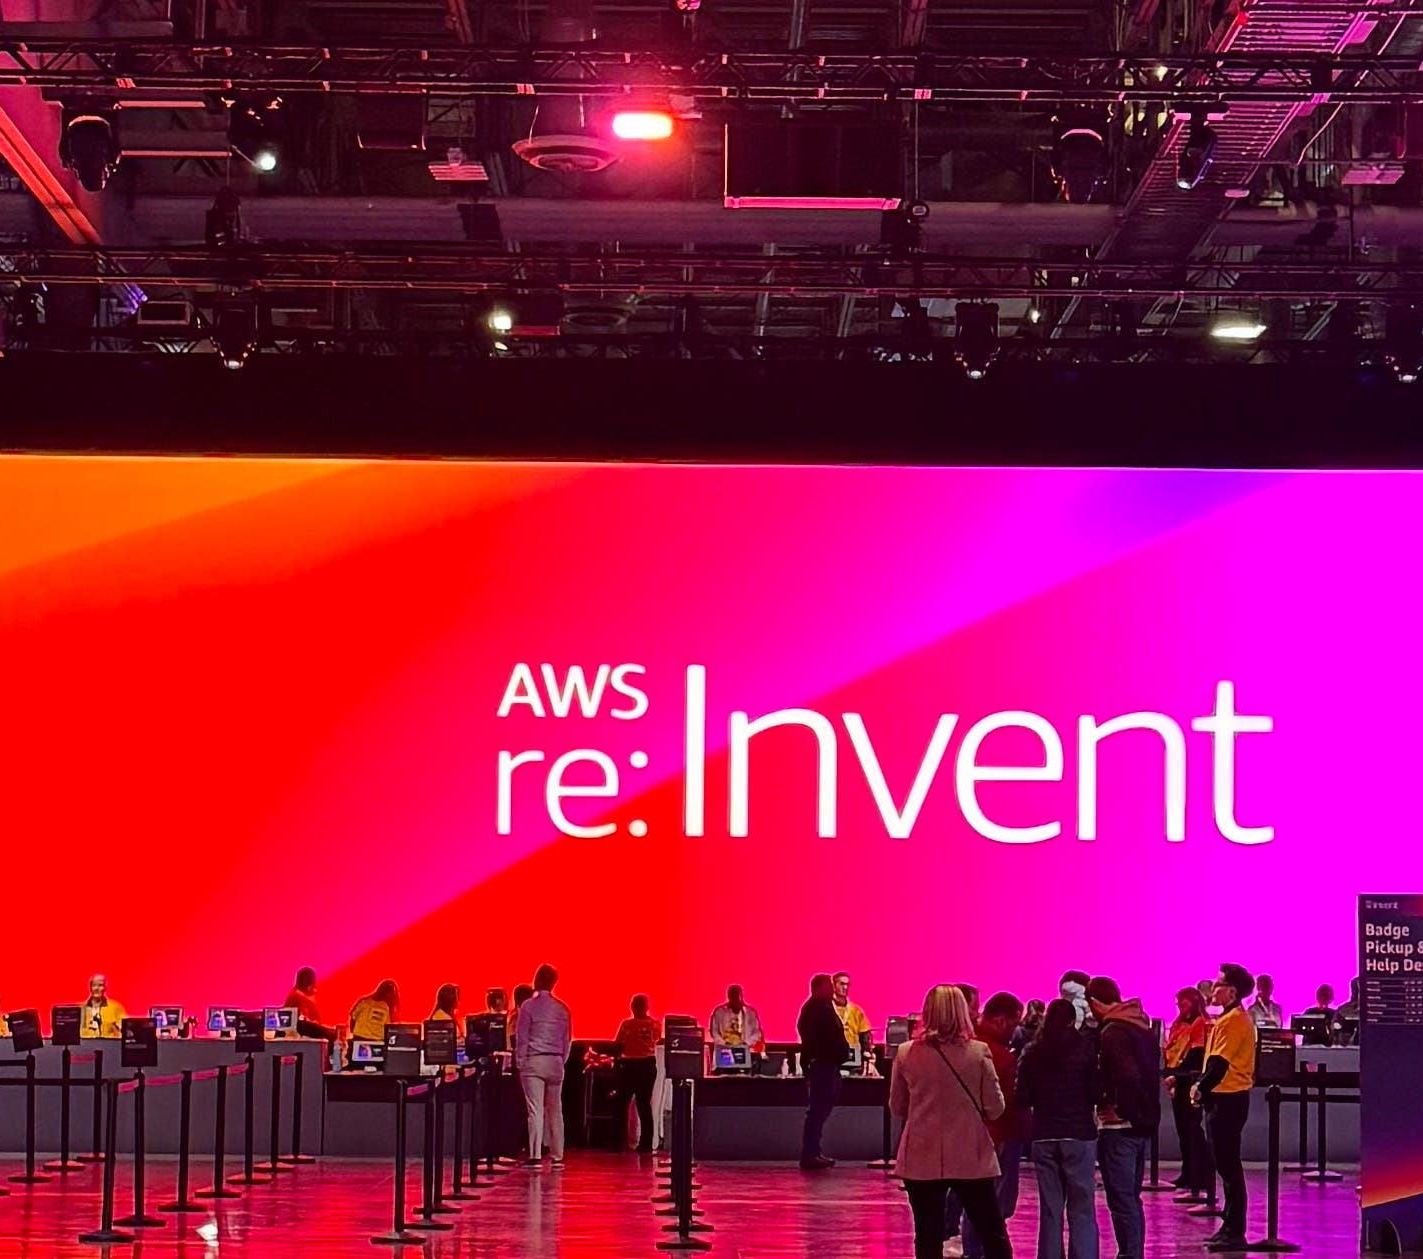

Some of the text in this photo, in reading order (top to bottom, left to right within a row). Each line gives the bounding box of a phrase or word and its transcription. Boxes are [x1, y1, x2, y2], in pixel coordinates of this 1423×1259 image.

[497, 663, 648, 719] AWS
[497, 664, 1274, 844] re:Invent
[1365, 923, 1410, 939] Badge
[1365, 941, 1414, 956] Pickup
[1366, 958, 1399, 974] Help
